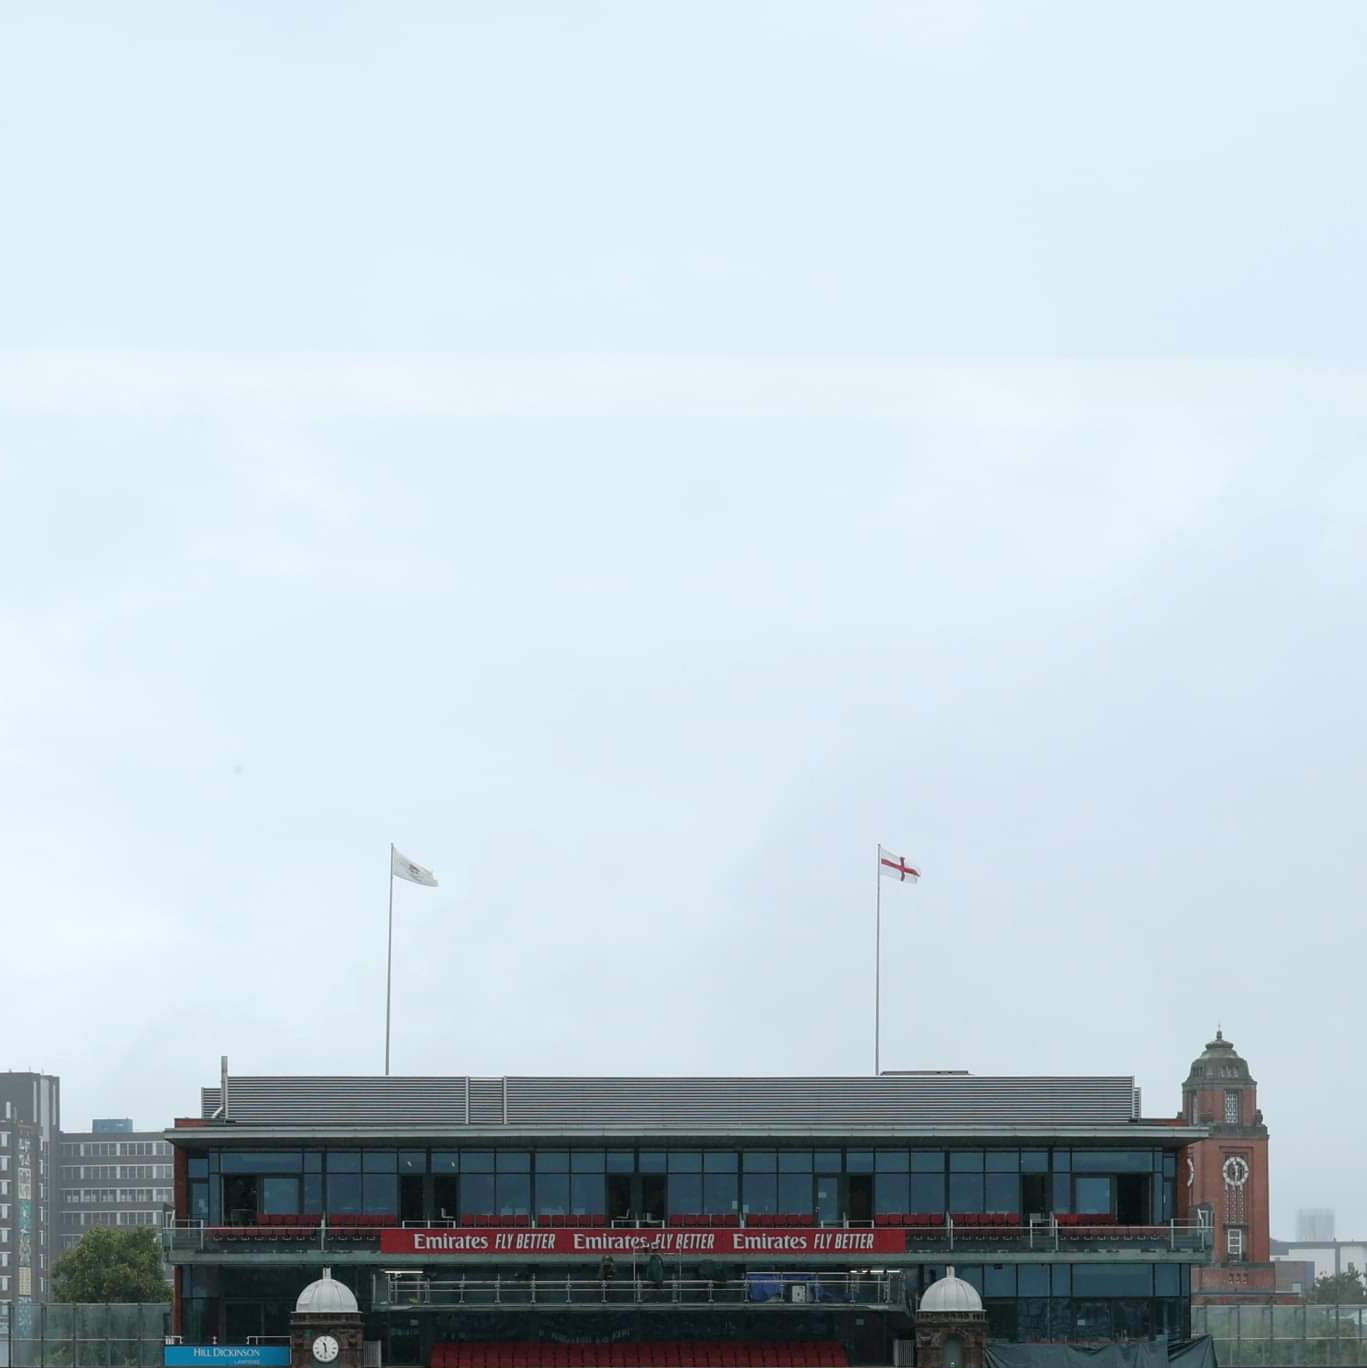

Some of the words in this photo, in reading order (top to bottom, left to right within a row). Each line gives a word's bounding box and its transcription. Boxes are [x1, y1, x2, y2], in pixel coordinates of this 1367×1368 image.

[415, 1233, 489, 1249] Emirates
[495, 1233, 514, 1249] FLY
[516, 1233, 556, 1249] BETTER
[574, 1233, 648, 1249] Emirates
[654, 1233, 673, 1249] FLY
[675, 1233, 715, 1249] BETTER
[733, 1233, 807, 1249] Emirates
[813, 1233, 832, 1249] FLY
[835, 1233, 874, 1249] BETTER
[193, 1347, 213, 1357] HILL
[213, 1347, 261, 1357] DICKINSON
